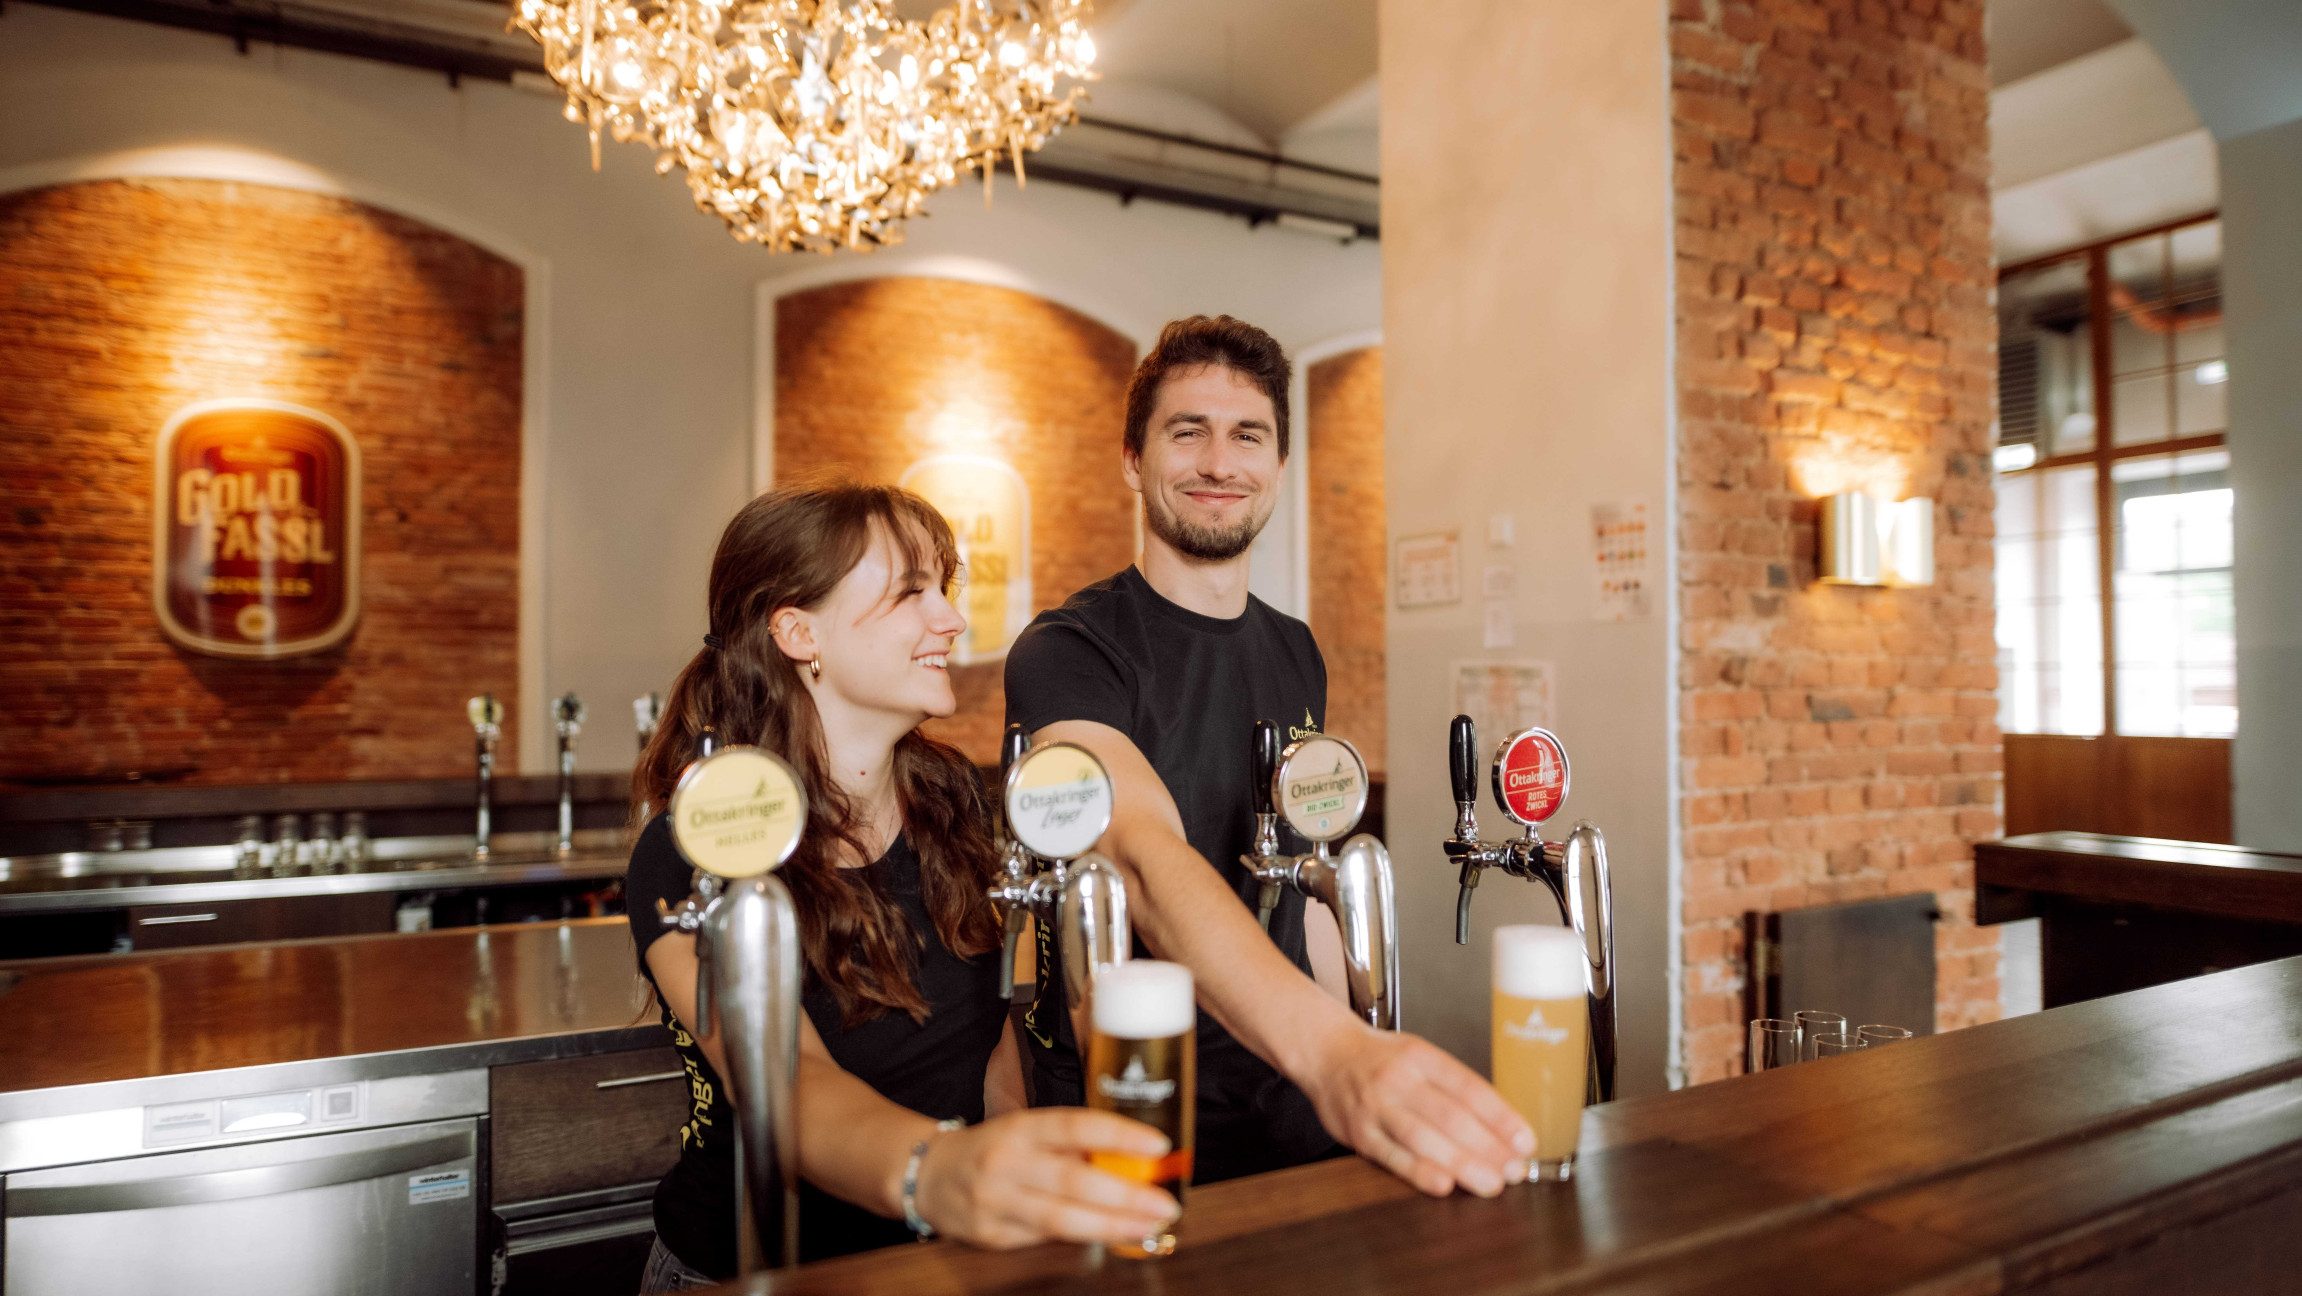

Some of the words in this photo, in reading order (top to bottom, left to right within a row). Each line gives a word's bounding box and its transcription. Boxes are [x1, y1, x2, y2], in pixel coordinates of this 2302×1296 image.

[178, 467, 302, 528] GOLD
[202, 513, 335, 566] FASSL
[1291, 776, 1355, 799] Ottakringer
[1509, 768, 1561, 788] Ottakringer
[1020, 787, 1101, 811] Ottakringer
[1526, 800, 1549, 812] ZWICKL
[1528, 790, 1548, 802] ROTES
[689, 799, 786, 829] Ottakringer
